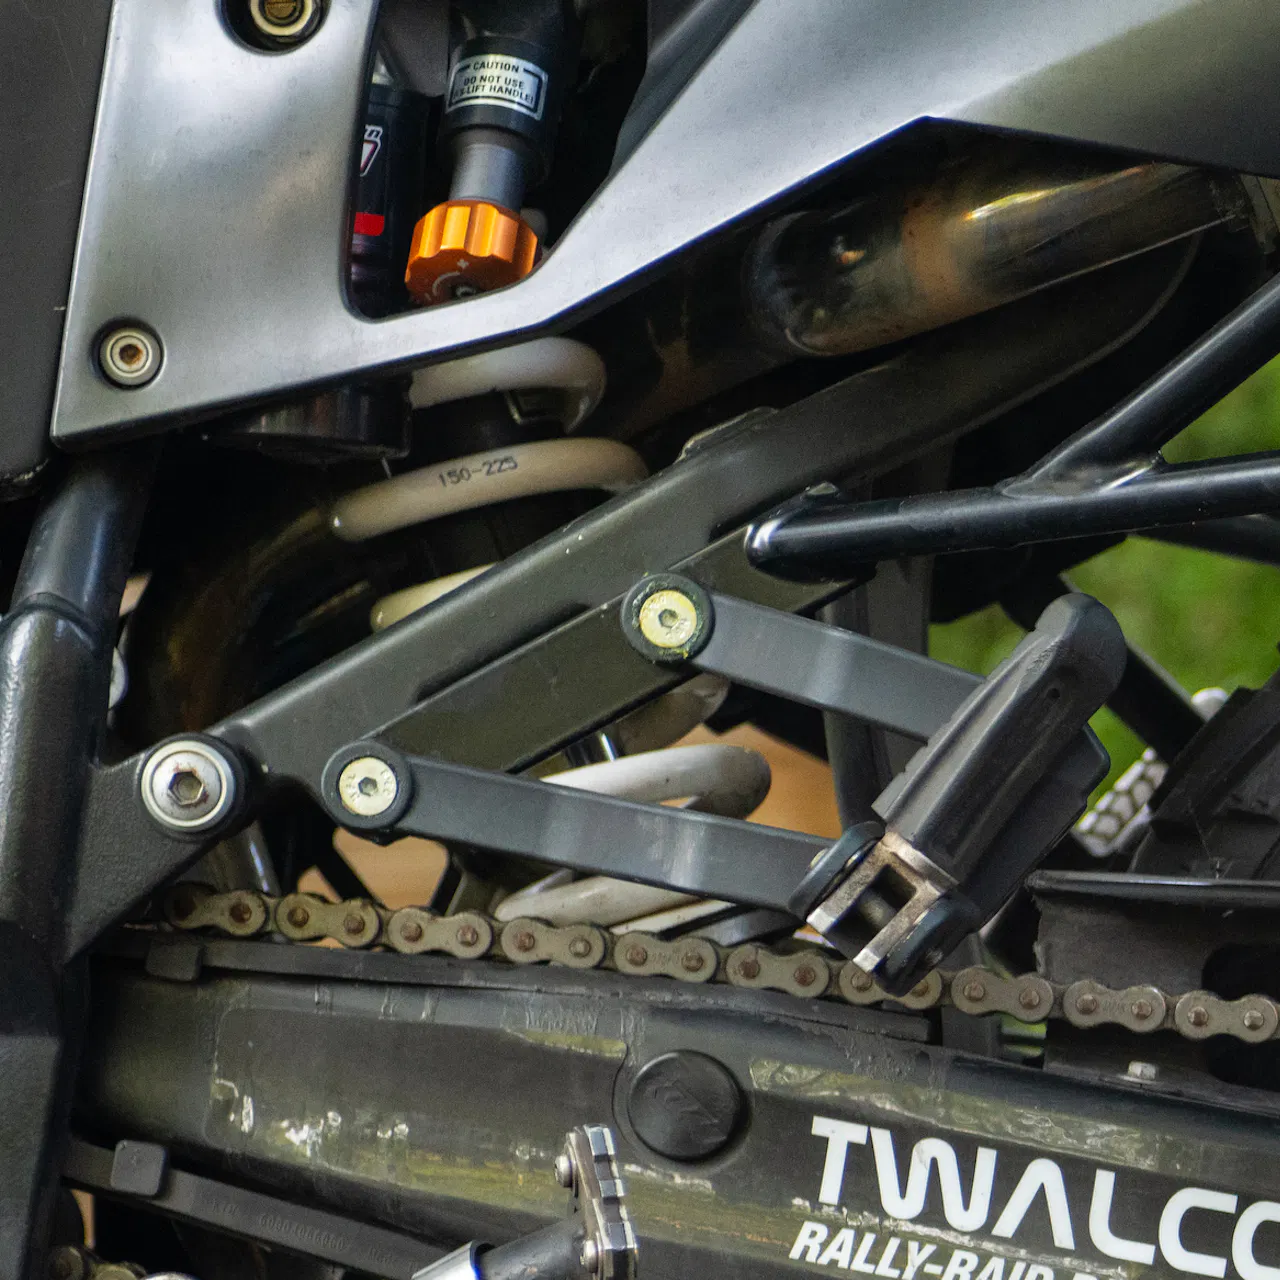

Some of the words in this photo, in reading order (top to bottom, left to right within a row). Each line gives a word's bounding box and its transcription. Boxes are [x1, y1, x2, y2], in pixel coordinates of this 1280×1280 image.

[473, 61, 520, 73] CAUTION
[464, 76, 477, 87] DO
[480, 75, 501, 84] NOT
[504, 77, 525, 90] USE
[466, 84, 486, 95] LIFT
[439, 456, 518, 487] 150-225
